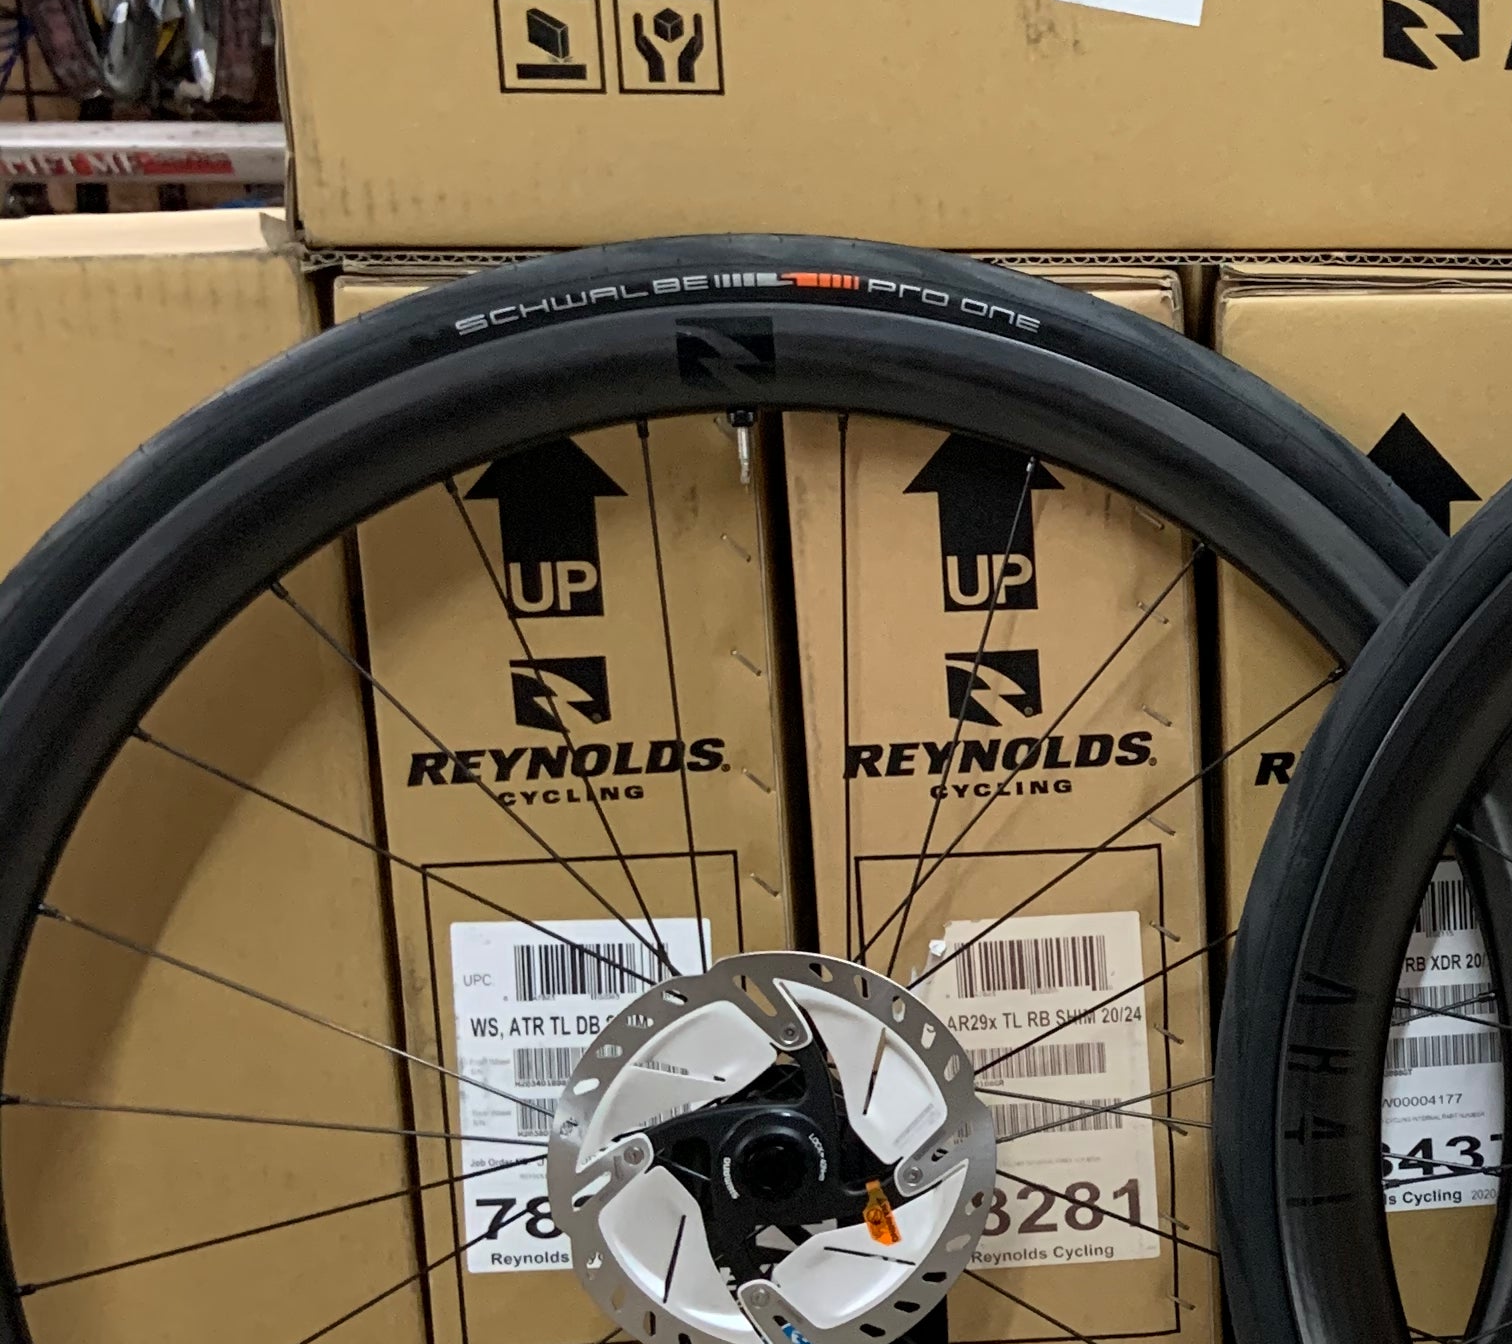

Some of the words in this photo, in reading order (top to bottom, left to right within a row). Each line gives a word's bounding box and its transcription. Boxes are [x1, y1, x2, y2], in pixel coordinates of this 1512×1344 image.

[454, 274, 709, 337] SCHWALBE
[508, 560, 598, 613] UP
[945, 553, 1034, 607] UP
[407, 737, 726, 787] REYNOLDS
[843, 731, 1153, 779] REYNOLDS
[498, 784, 645, 807] CYCLING
[929, 778, 1073, 800] CYCLING
[1405, 956, 1426, 973] RB
[1430, 955, 1462, 971] XDR
[1465, 952, 1488, 970] 20/
[463, 973, 492, 987] UPC
[471, 1016, 504, 1040] WS,
[509, 1015, 545, 1037] ATR
[552, 1014, 571, 1036] TL
[577, 1014, 601, 1035] DB
[1003, 1011, 1022, 1030] TL
[1027, 1010, 1050, 1029] RB
[1056, 1008, 1096, 1027] SHIM
[1101, 1006, 1142, 1024] 20/24
[1402, 1188, 1463, 1207] Cycling
[491, 1250, 570, 1269] Reynolds
[971, 1247, 1048, 1266] Reynolds
[1053, 1243, 1115, 1260] Cycling
